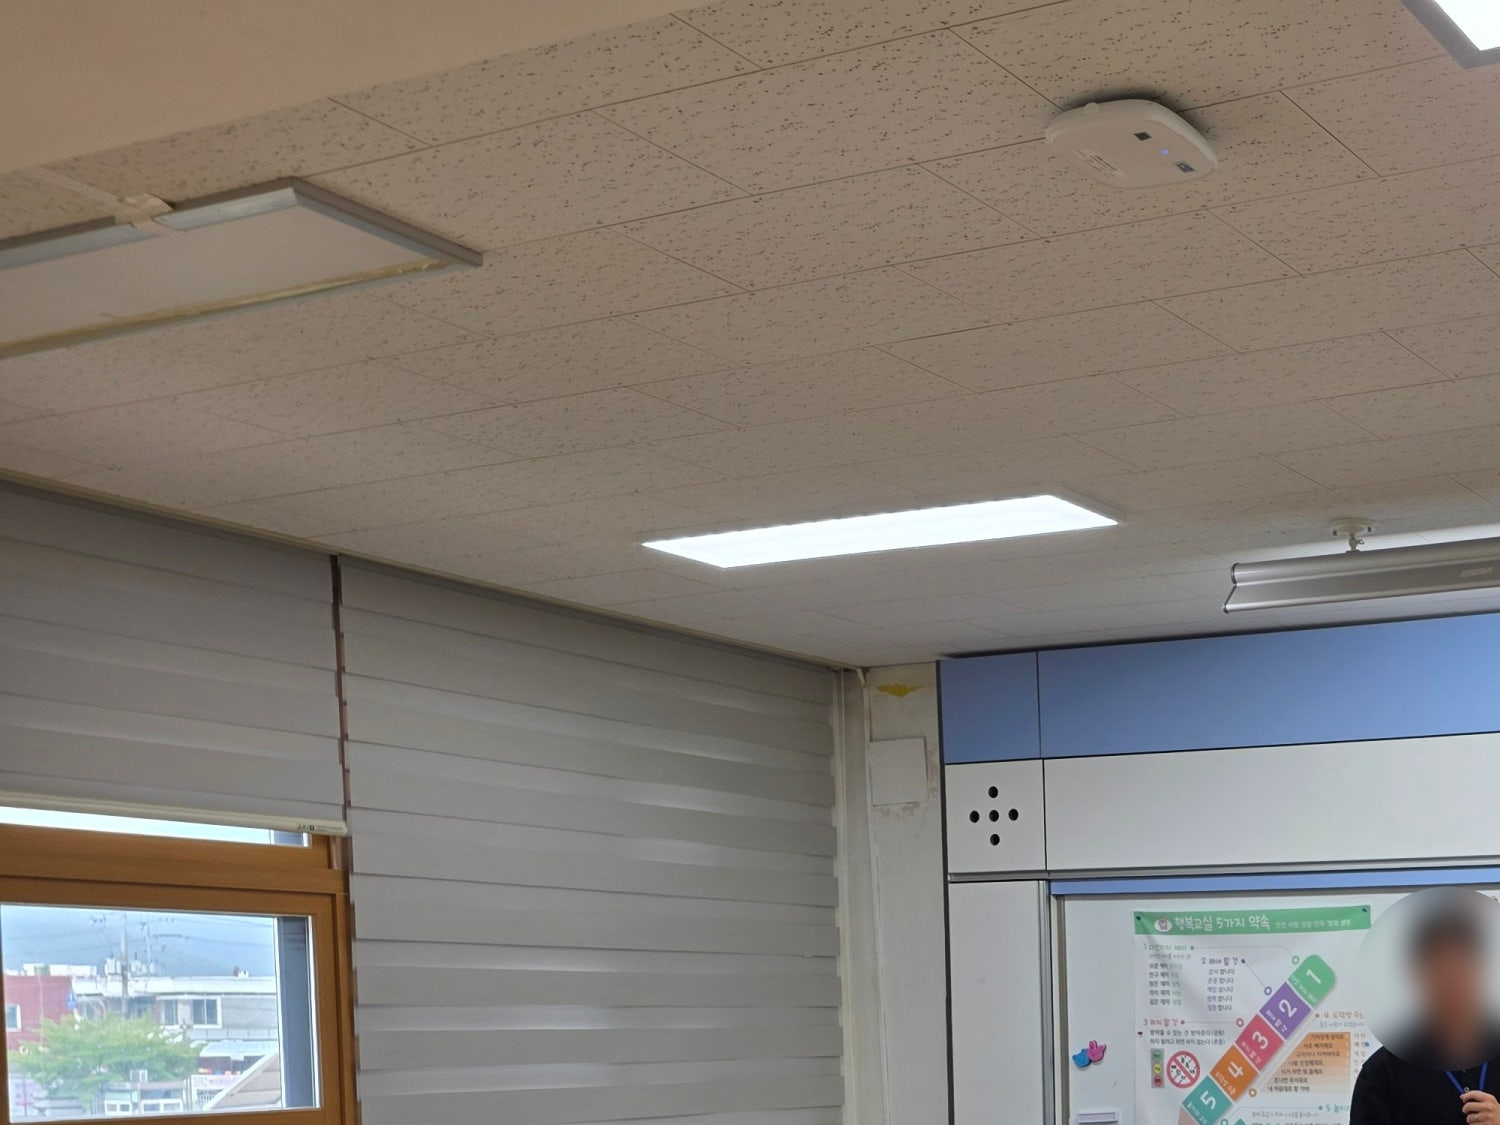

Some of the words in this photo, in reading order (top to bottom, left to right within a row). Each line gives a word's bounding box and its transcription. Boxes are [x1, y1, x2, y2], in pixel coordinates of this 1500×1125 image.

[1174, 916, 1213, 931] 행복교실
[1216, 917, 1245, 928] 5가지
[1249, 915, 1270, 929] 약속
[1306, 969, 1322, 984] 1
[1279, 999, 1297, 1018] 2
[1252, 1031, 1269, 1049] 3
[1227, 1062, 1244, 1079] 4
[1201, 1091, 1217, 1110] 5
